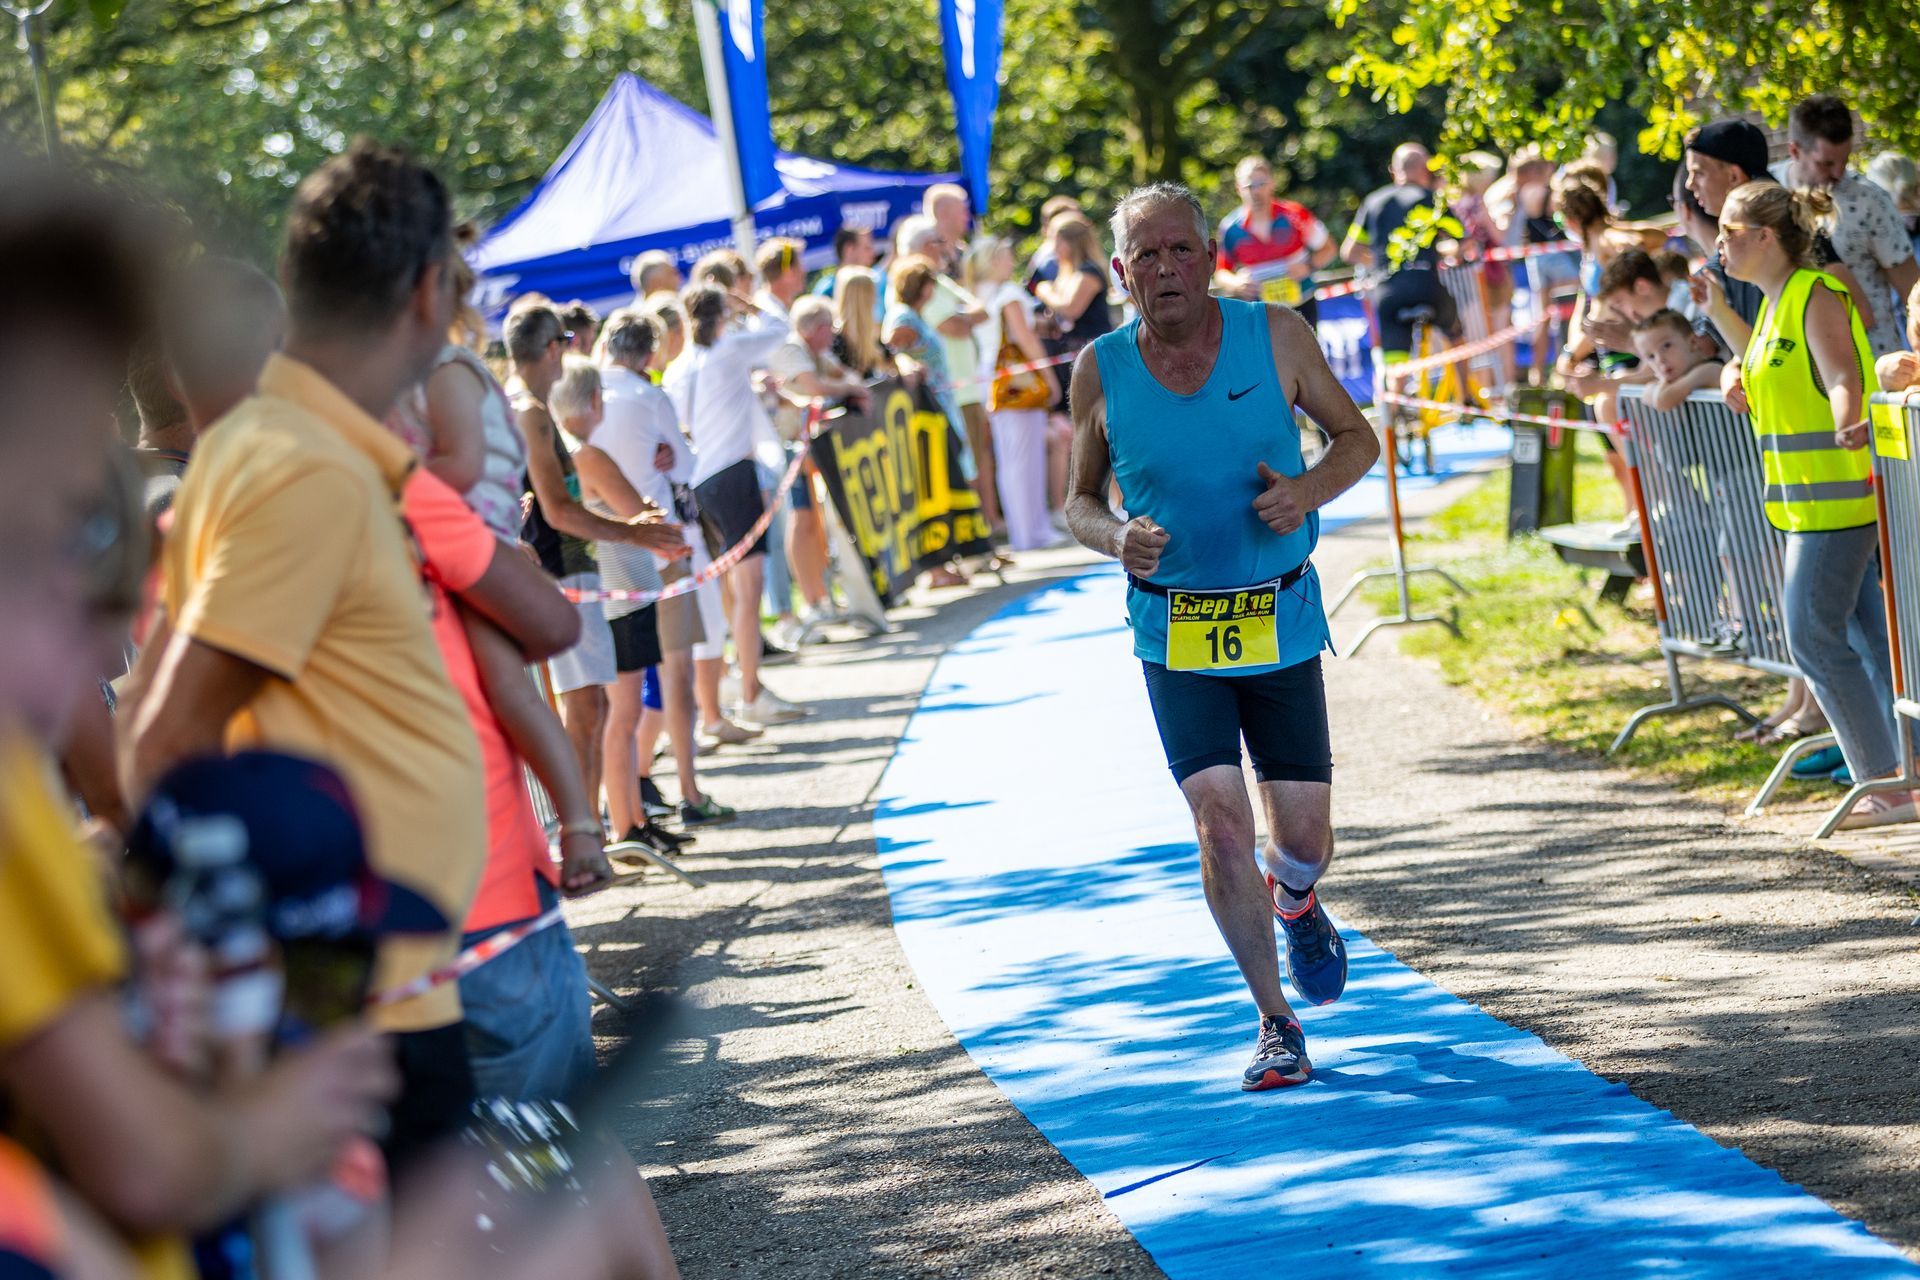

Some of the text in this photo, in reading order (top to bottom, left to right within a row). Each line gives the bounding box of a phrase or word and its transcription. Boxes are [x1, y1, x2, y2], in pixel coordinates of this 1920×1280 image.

[1171, 592, 1274, 619] Step One
[1205, 624, 1243, 664] 16
